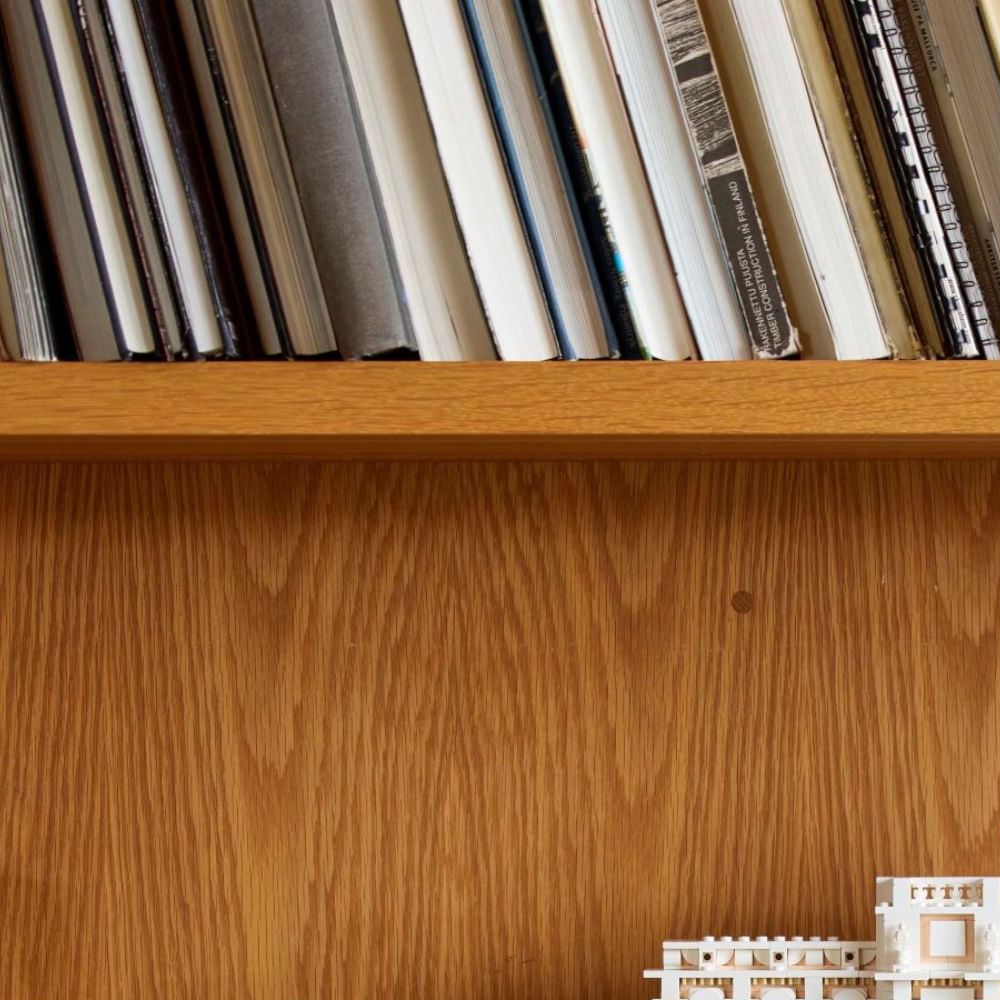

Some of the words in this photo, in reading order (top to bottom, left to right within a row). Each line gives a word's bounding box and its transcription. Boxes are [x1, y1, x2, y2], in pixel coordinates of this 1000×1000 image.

[920, 28, 937, 72] MALLORCA
[728, 181, 748, 223] FINLAND
[740, 223, 751, 234] IN
[736, 248, 755, 287] PUUSTA
[744, 235, 774, 312] CONSTRUCTION
[746, 288, 772, 352] RAKENNETTU
[766, 312, 784, 350] TIMBER
